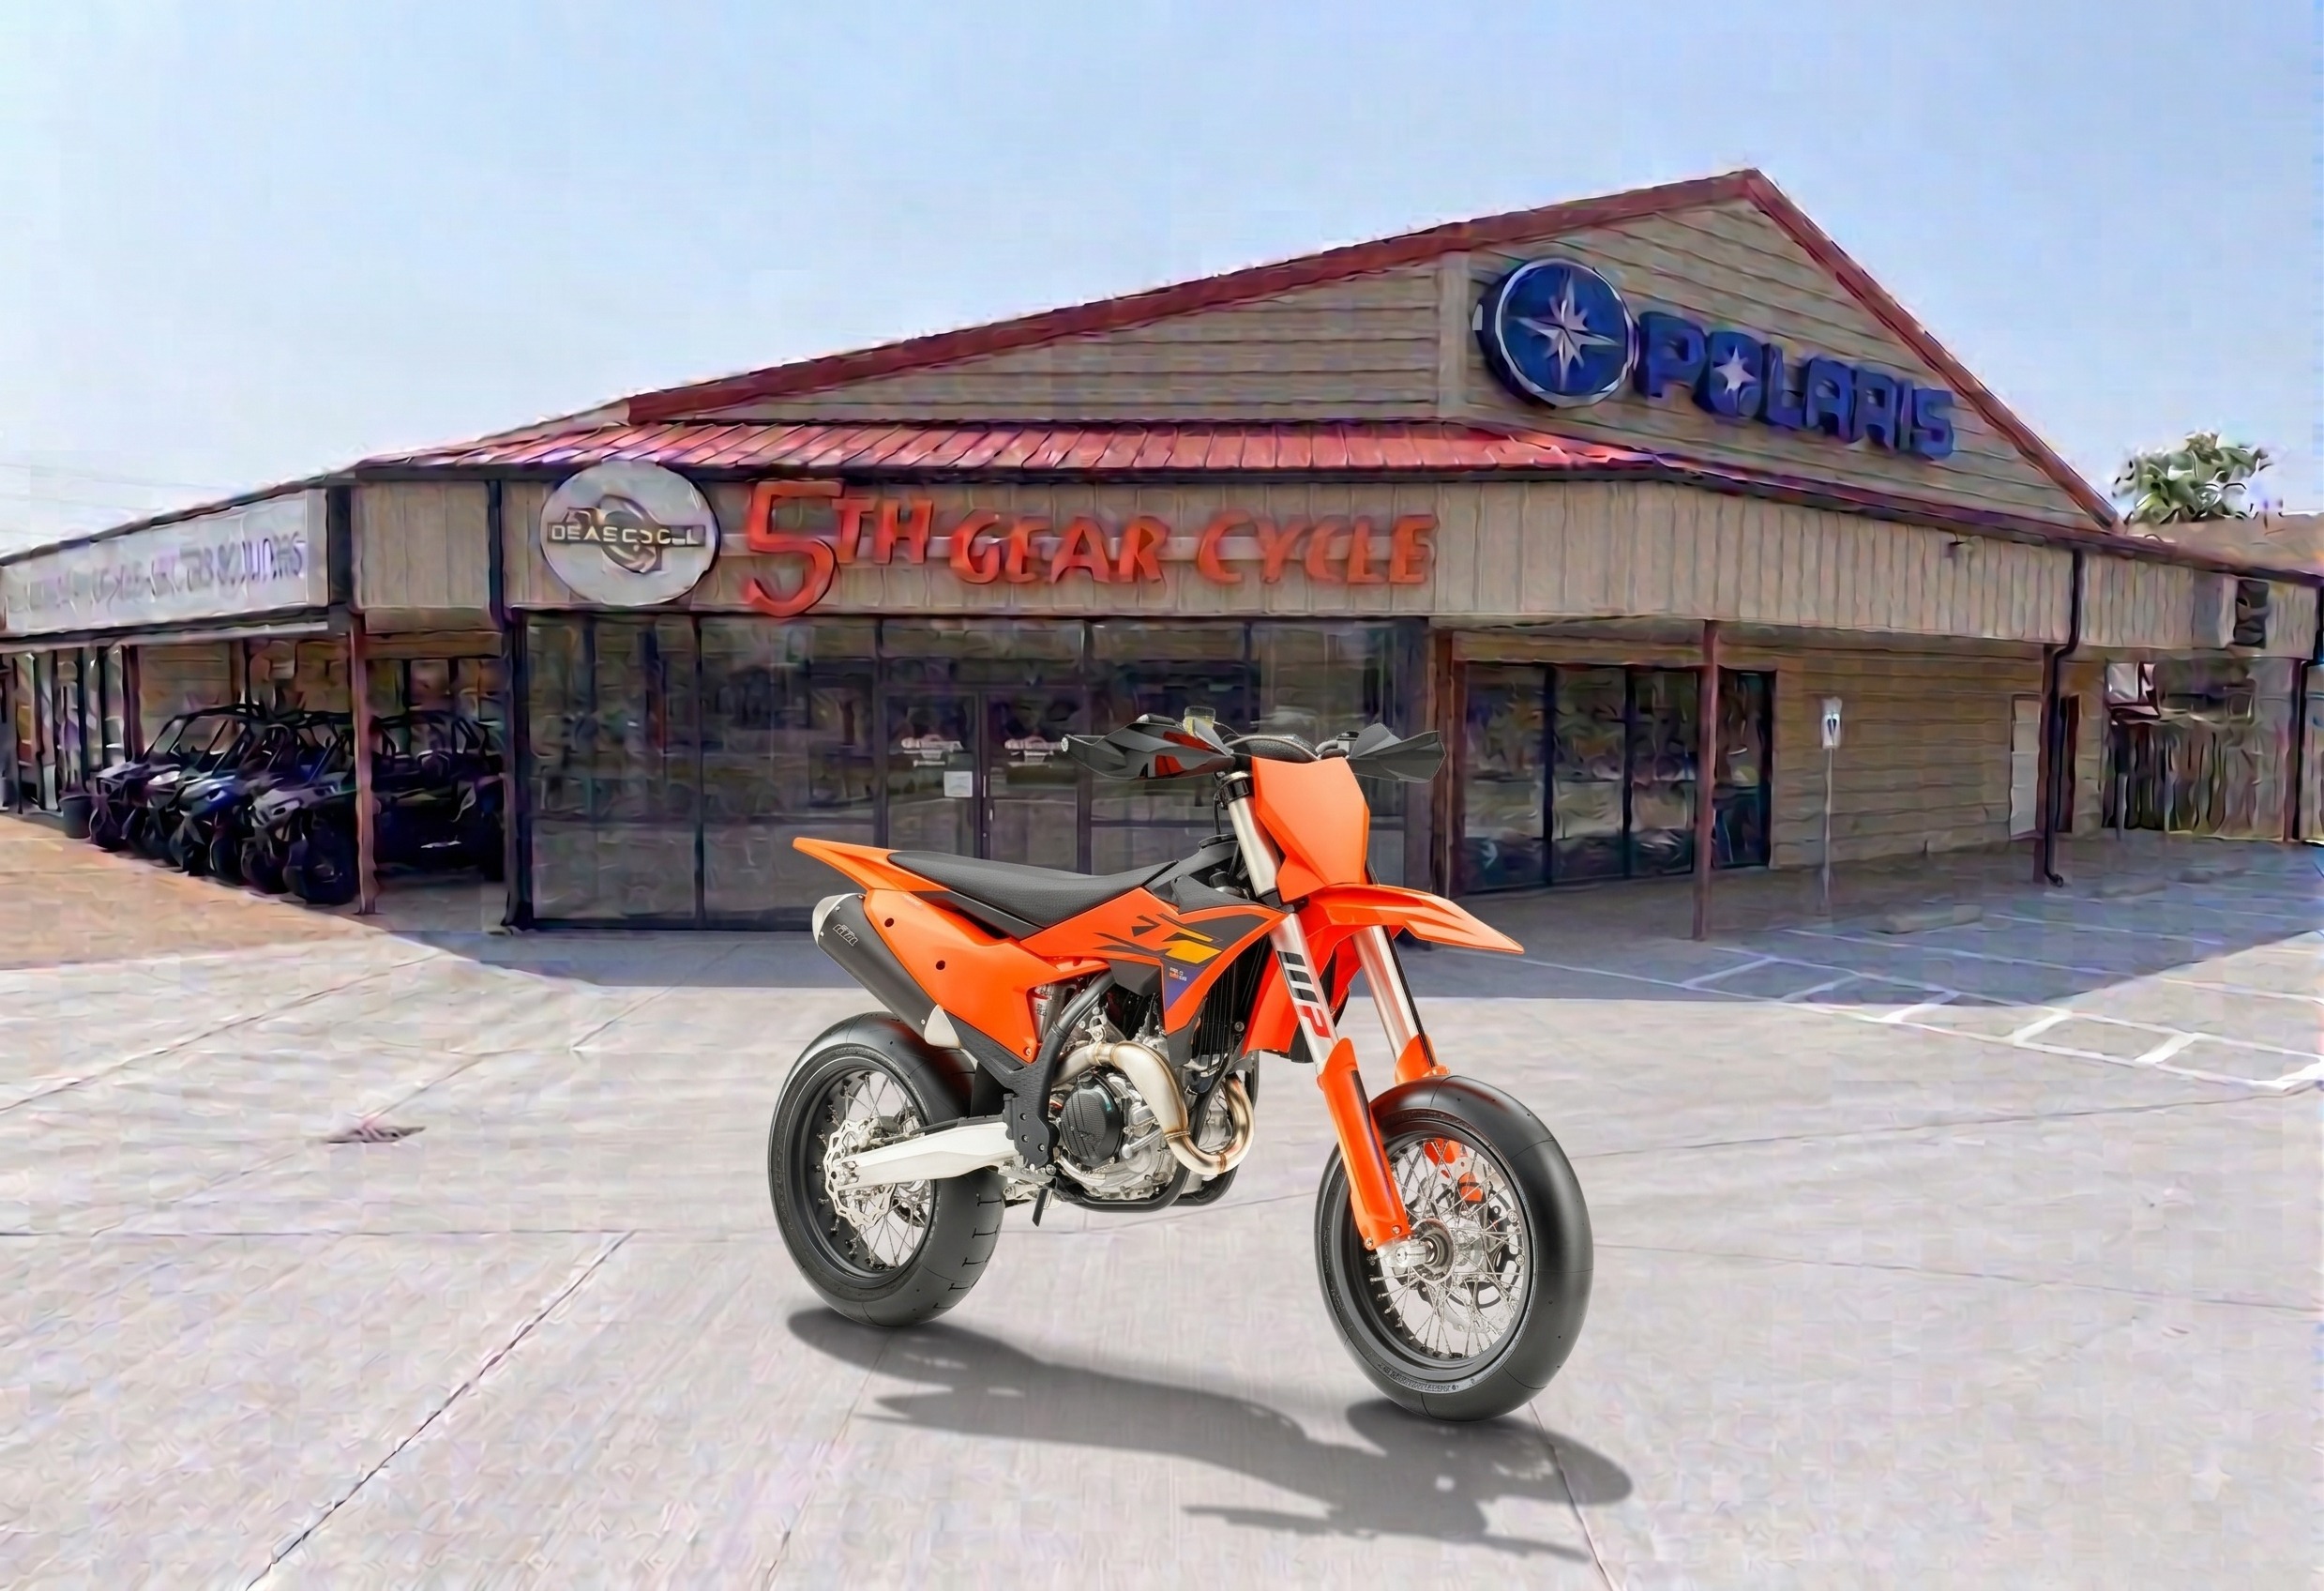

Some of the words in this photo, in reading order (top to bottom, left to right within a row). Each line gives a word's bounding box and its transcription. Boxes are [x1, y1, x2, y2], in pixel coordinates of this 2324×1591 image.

[1637, 311, 1955, 462] POLARIS
[747, 477, 934, 617] 5TH
[948, 508, 1170, 585] GEAR
[1196, 508, 1441, 586] CYCLE
